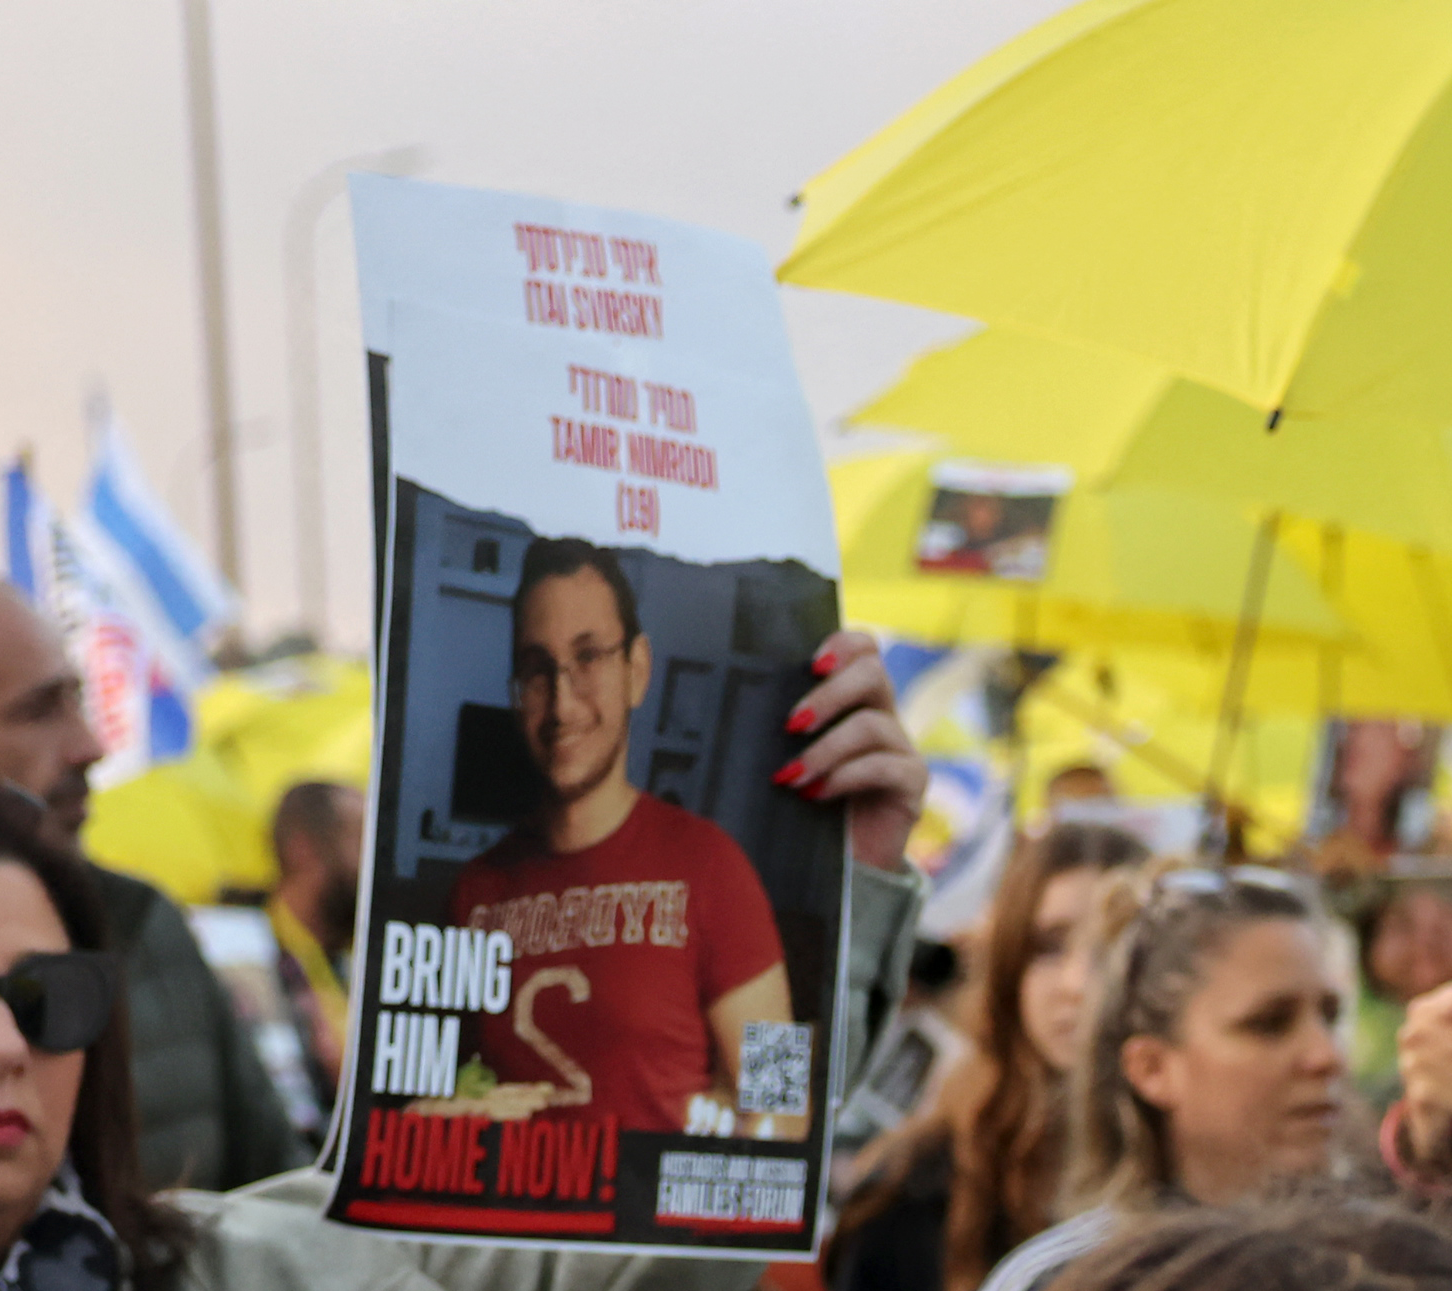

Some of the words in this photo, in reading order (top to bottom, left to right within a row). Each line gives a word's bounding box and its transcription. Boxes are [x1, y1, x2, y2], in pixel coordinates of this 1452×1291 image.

[525, 281, 568, 326] ITAI
[573, 286, 663, 338] SVIRSKY
[550, 415, 621, 471] TAMIR
[628, 433, 719, 491] NIMRODI
[380, 920, 513, 1014] BRING
[371, 1010, 461, 1097] HIM
[360, 1108, 490, 1193] HOME
[497, 1114, 619, 1201] NOW!
